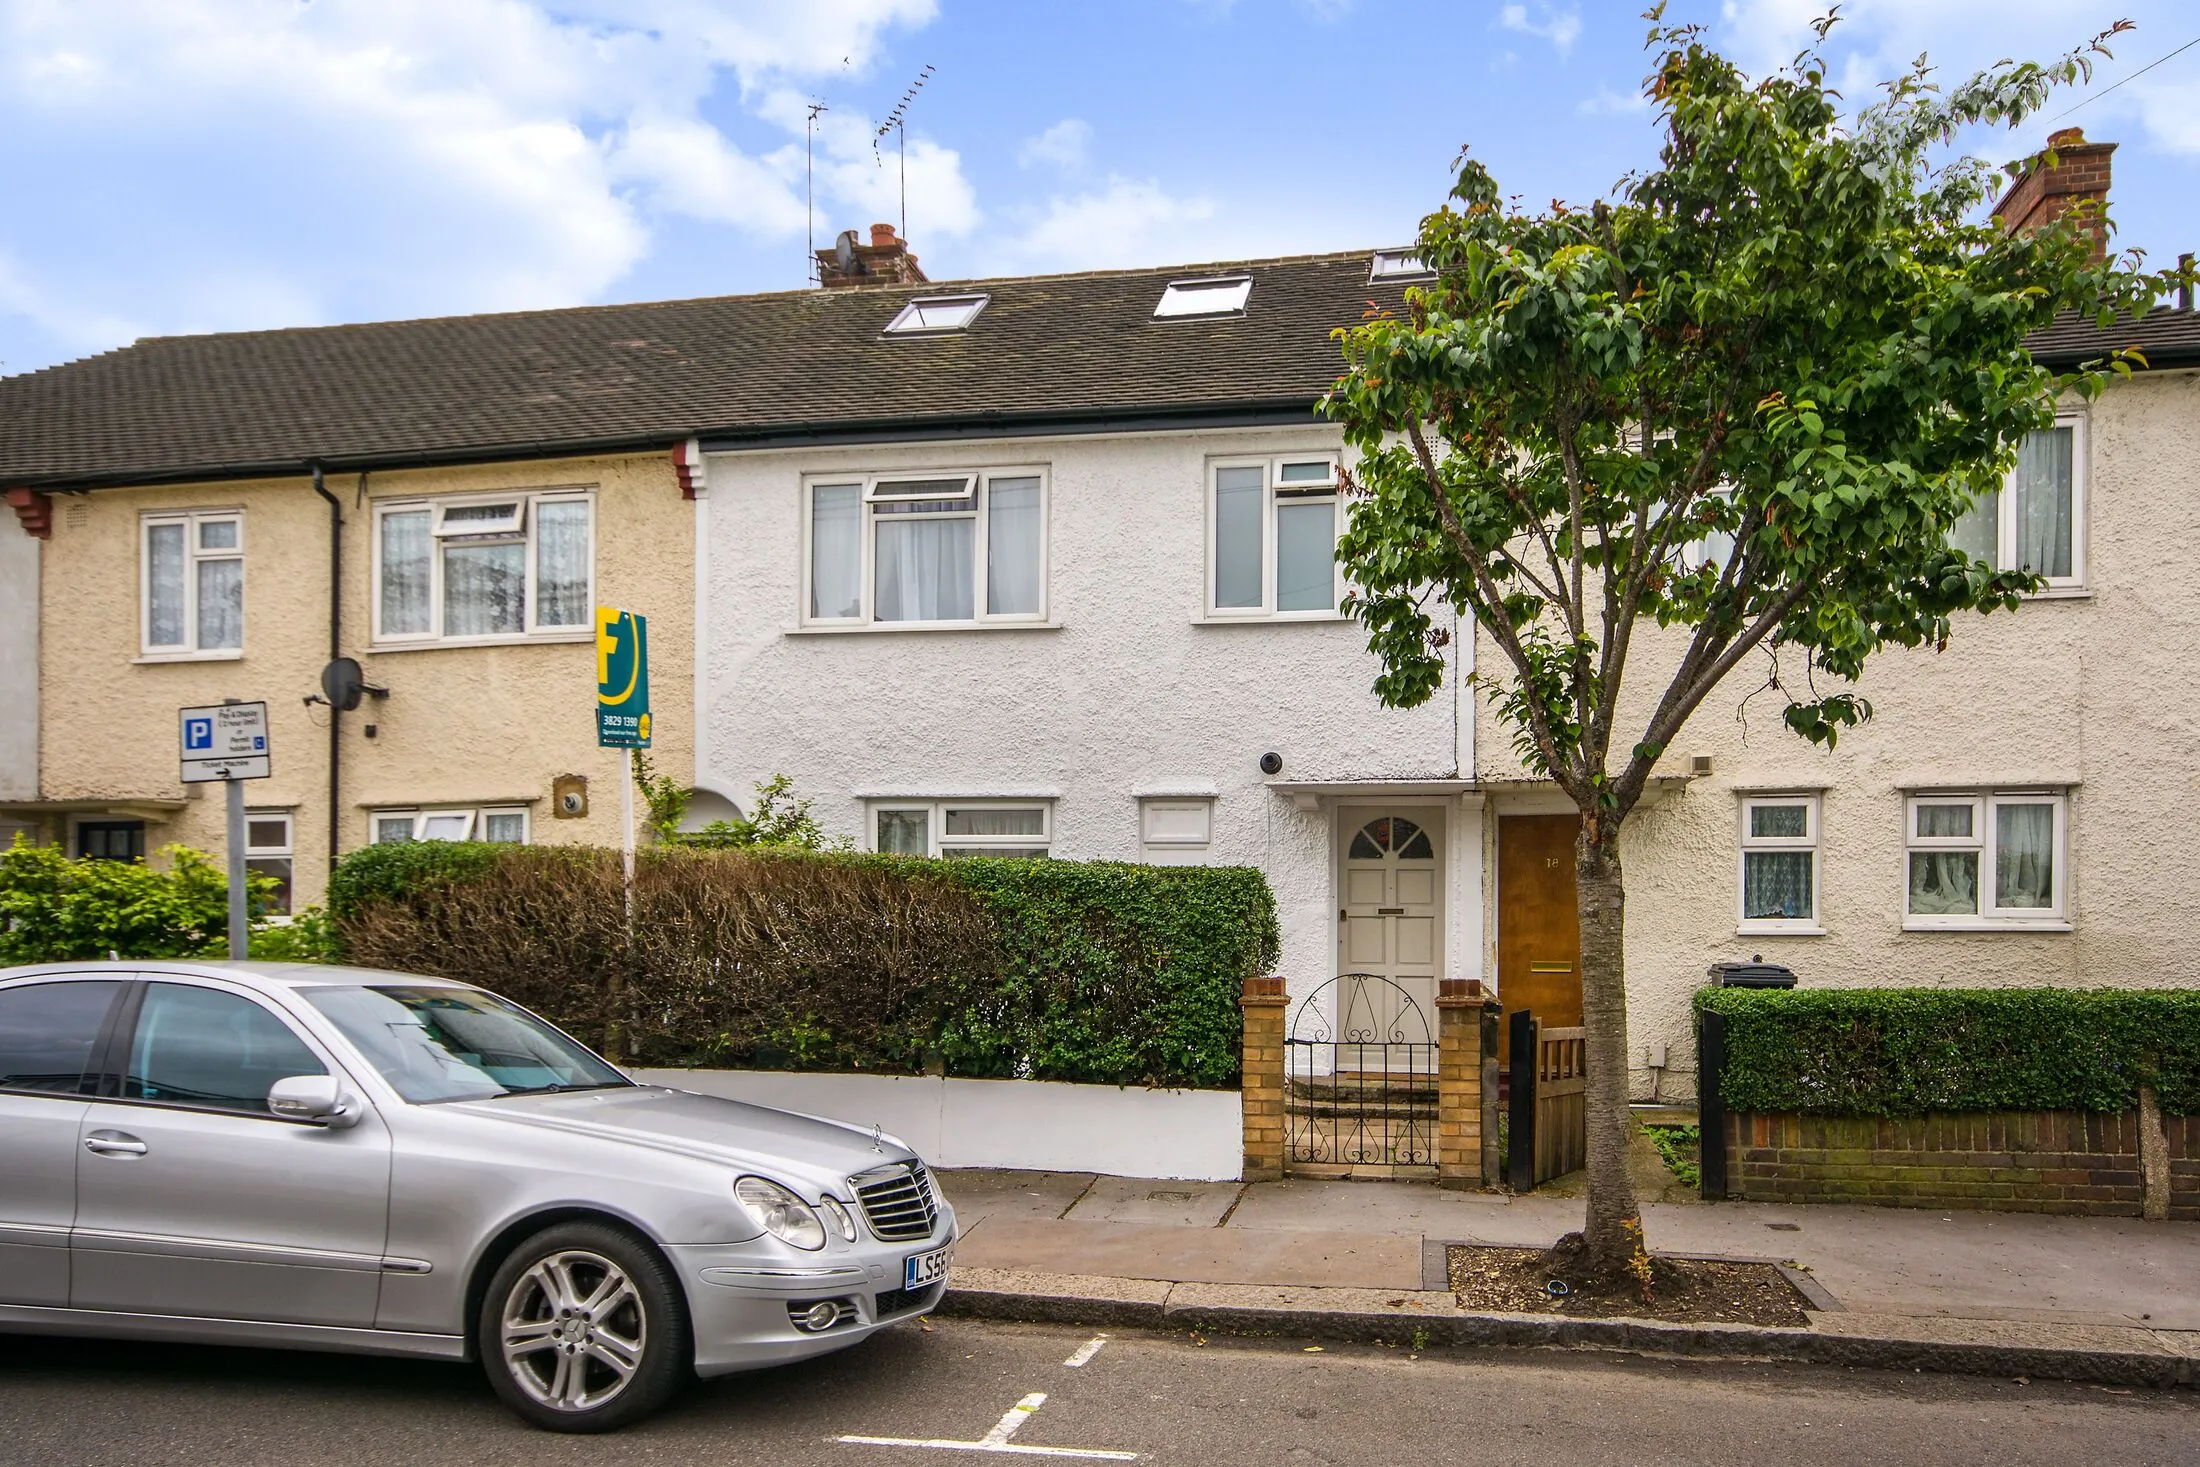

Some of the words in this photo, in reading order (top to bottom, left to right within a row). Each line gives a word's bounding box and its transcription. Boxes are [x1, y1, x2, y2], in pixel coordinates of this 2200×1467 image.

[597, 607, 621, 683] F
[191, 721, 208, 748] P
[603, 715, 622, 726] 3829
[623, 716, 638, 727] 1390
[916, 1251, 946, 1283] LS56
